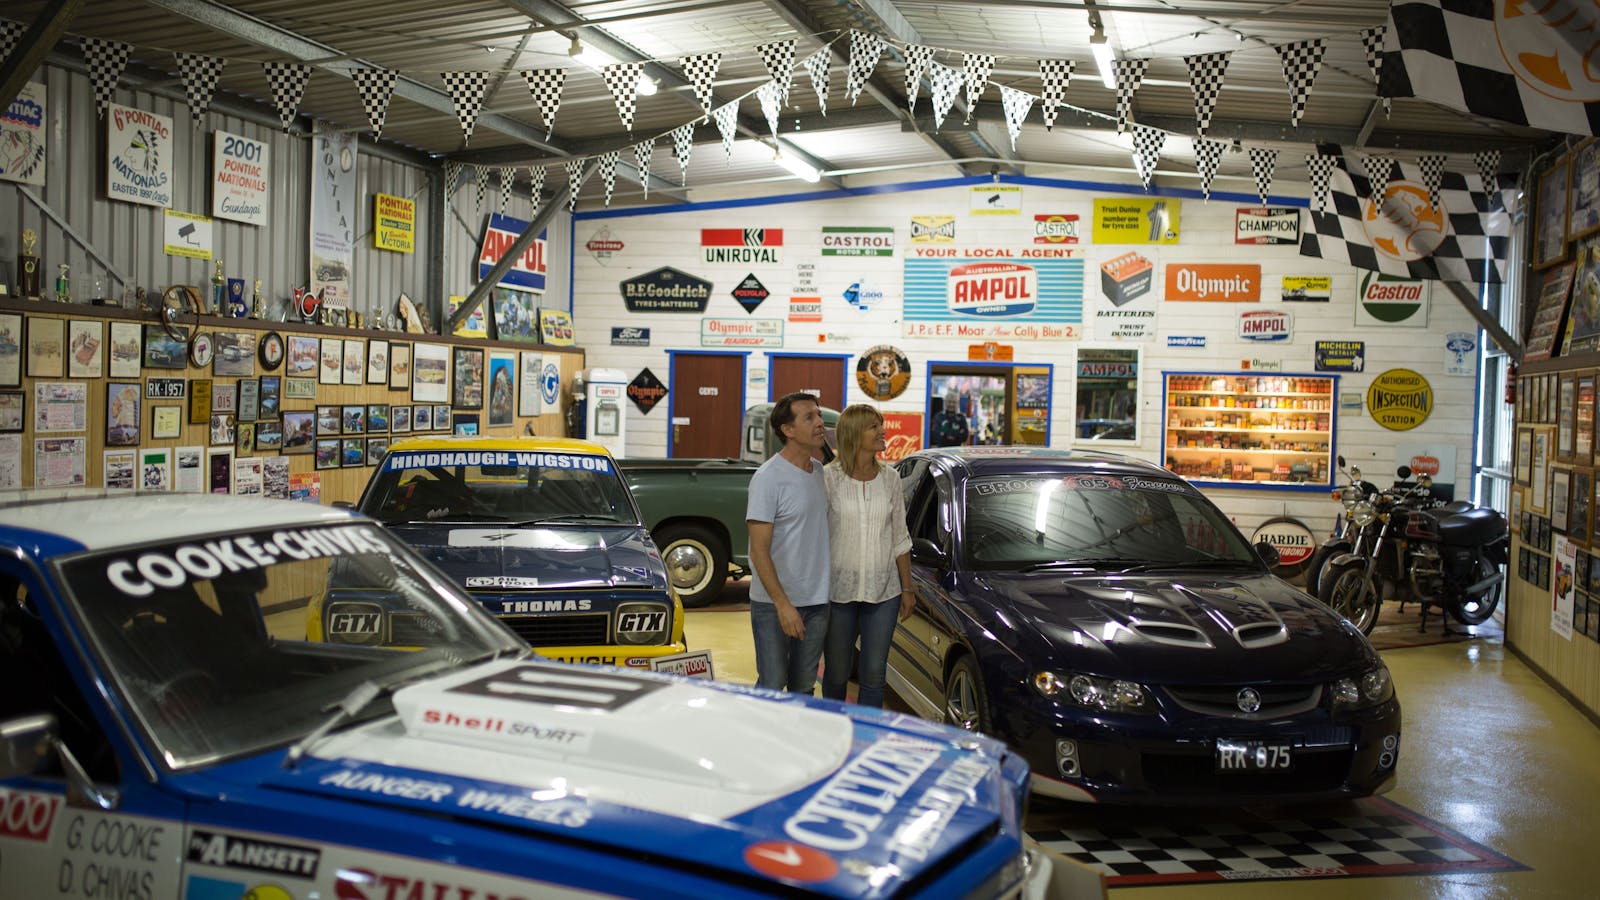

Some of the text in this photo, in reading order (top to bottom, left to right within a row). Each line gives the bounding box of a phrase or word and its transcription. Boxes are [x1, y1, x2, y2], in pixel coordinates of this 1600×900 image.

[125, 110, 169, 140] PONTIAC
[223, 136, 262, 163] 2001
[112, 156, 168, 188] NATIONALS
[224, 159, 262, 178] PONTIAC
[112, 182, 138, 199] EASTER
[217, 172, 266, 193] NATIONALS
[320, 138, 352, 243] PONTIAC
[380, 196, 413, 212] PONTIAC
[1119, 206, 1141, 214] Dunlop
[1270, 208, 1286, 216] PLUG
[380, 208, 413, 221] NATIONALS
[1035, 220, 1077, 236] CASTROL
[1238, 219, 1297, 232] CHAMPION
[380, 231, 411, 249] VICTORIA
[823, 236, 892, 247] CASTROL
[1255, 236, 1278, 244] SERVICE
[481, 230, 547, 273] AMOL
[706, 248, 778, 263] UNIROYAL
[916, 249, 1073, 257] YOUR LOCAL AGENT
[965, 265, 1018, 275] AUSTRALIAN
[954, 275, 1031, 303] AMPOL
[1176, 267, 1251, 299] Olympic
[1366, 283, 1424, 301] Castrol
[976, 305, 1007, 314] OWNED
[1097, 310, 1155, 318] BATTERIES
[710, 320, 753, 335] Olympic
[958, 324, 985, 336] Moar
[1042, 325, 1063, 337] Blue
[1243, 319, 1286, 333] AMPOL
[1318, 342, 1361, 350] MICHELIN
[1082, 362, 1137, 377] AMPOL
[1380, 376, 1421, 387] AUTHORISED
[627, 384, 665, 399] Olympic
[1372, 388, 1429, 413] INSPECTION
[883, 420, 902, 430] INK
[1381, 414, 1416, 426] STATION
[975, 477, 1046, 496] BROC
[1260, 534, 1309, 546] HARDIE
[502, 599, 592, 613] THOMAS
[332, 613, 379, 633] GTX
[618, 612, 666, 633] GTX
[423, 709, 504, 732] Shell
[508, 721, 586, 745] SPORT
[320, 769, 452, 802] AUNGER
[459, 789, 592, 829] WHEELS
[67, 815, 164, 862] G. COOKE
[58, 858, 155, 900] D. CHIVAS
